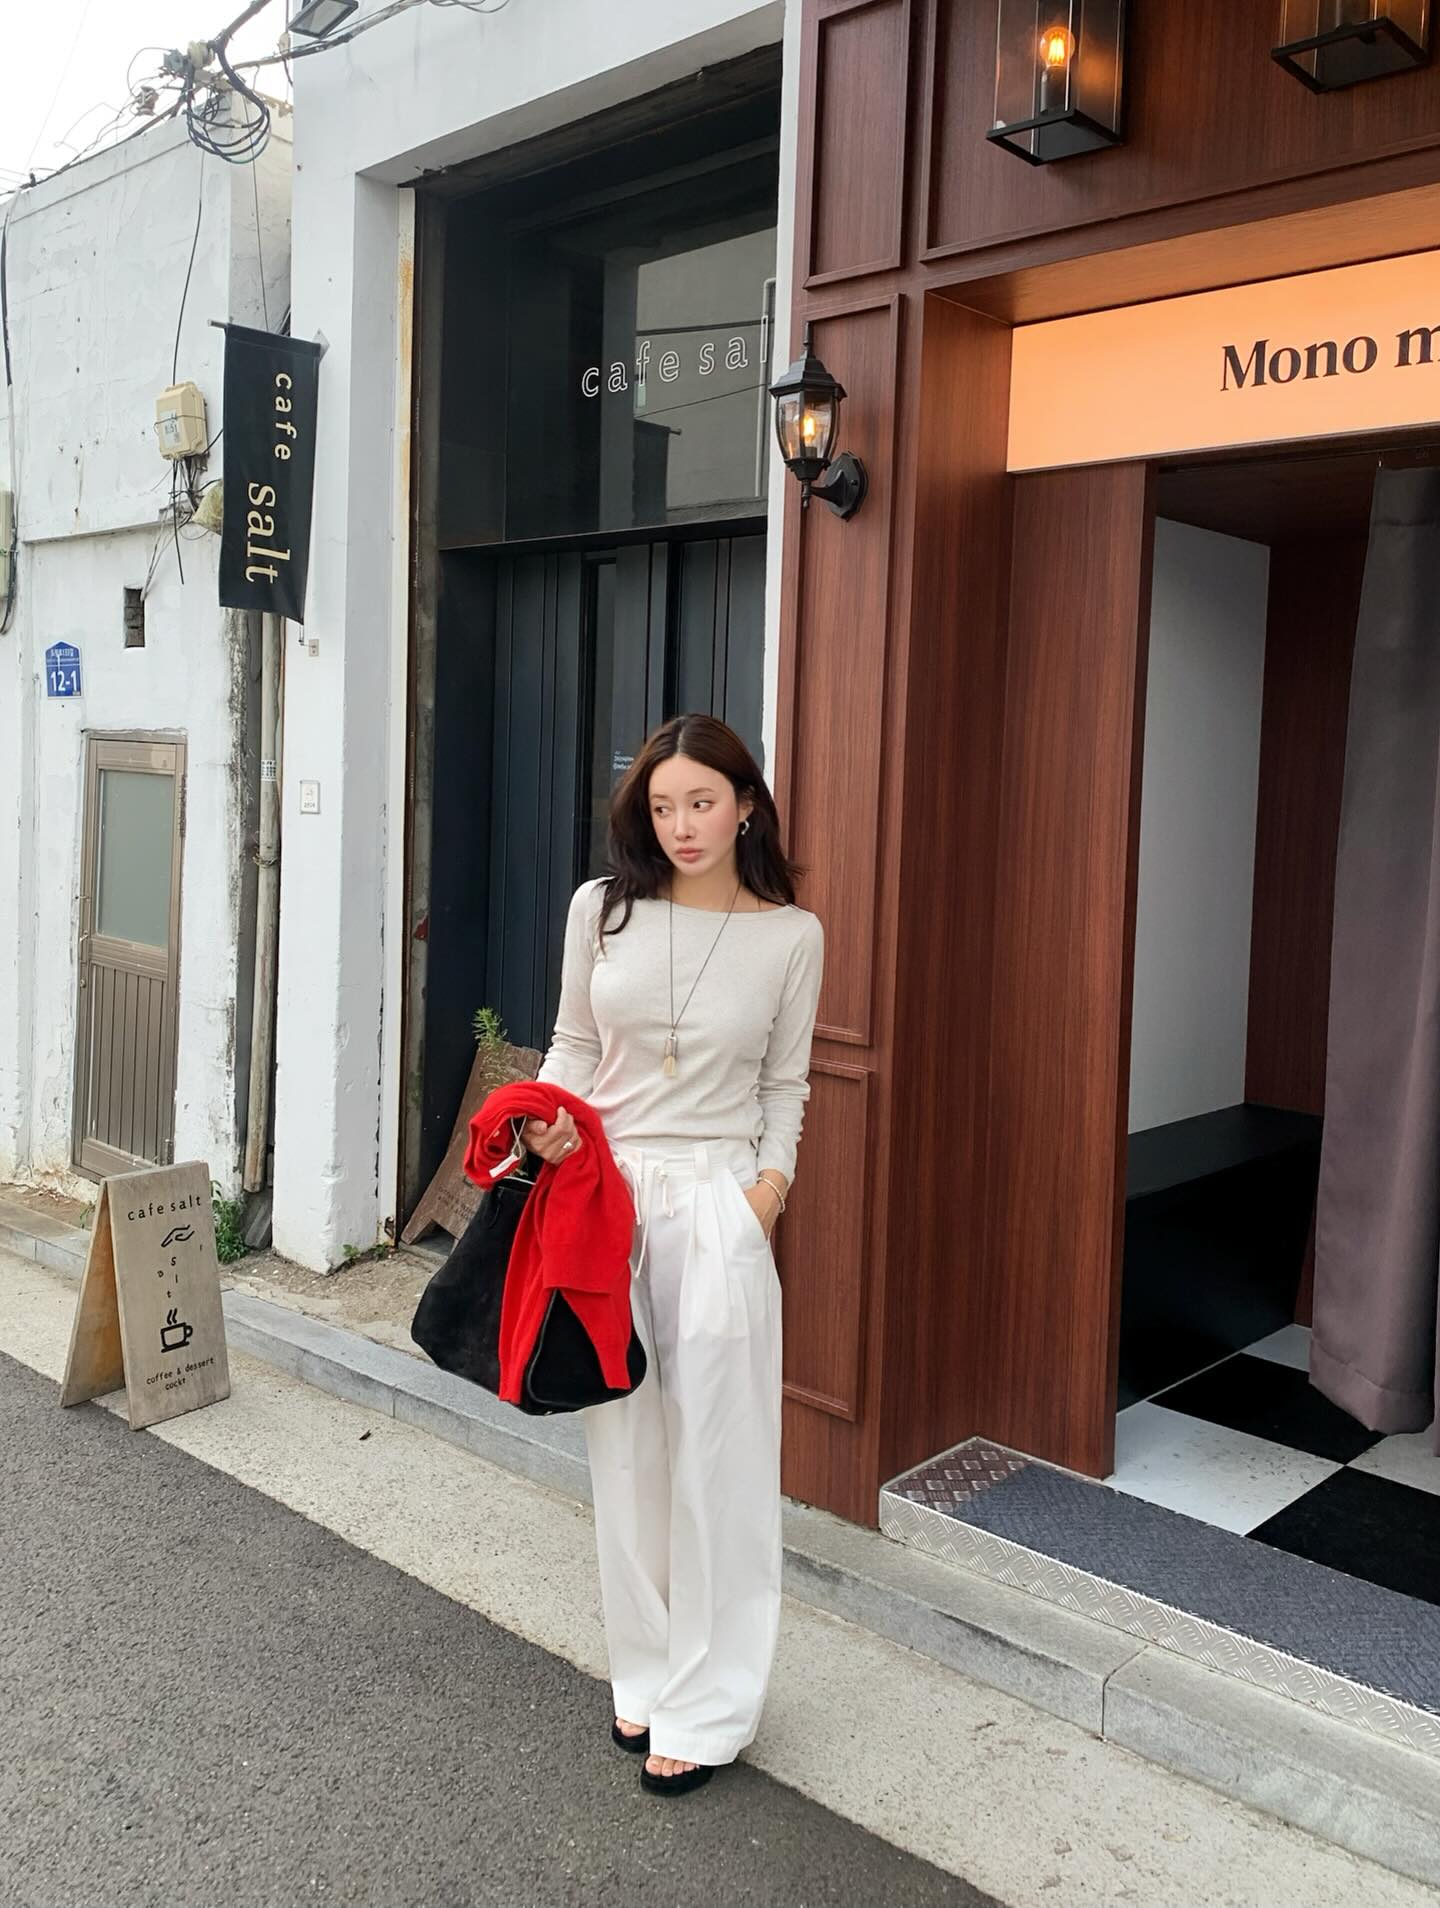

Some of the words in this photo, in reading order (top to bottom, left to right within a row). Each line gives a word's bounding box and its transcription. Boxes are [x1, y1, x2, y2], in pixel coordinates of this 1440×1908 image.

[581, 341, 680, 397] cafe
[1220, 335, 1378, 391] Mono
[274, 372, 297, 460] cafe
[245, 481, 291, 584] salt
[50, 670, 77, 691] 12-1
[128, 1202, 164, 1220] cafe
[170, 1194, 201, 1212] salt
[146, 1371, 173, 1385] coffee
[184, 1357, 214, 1373] dessert
